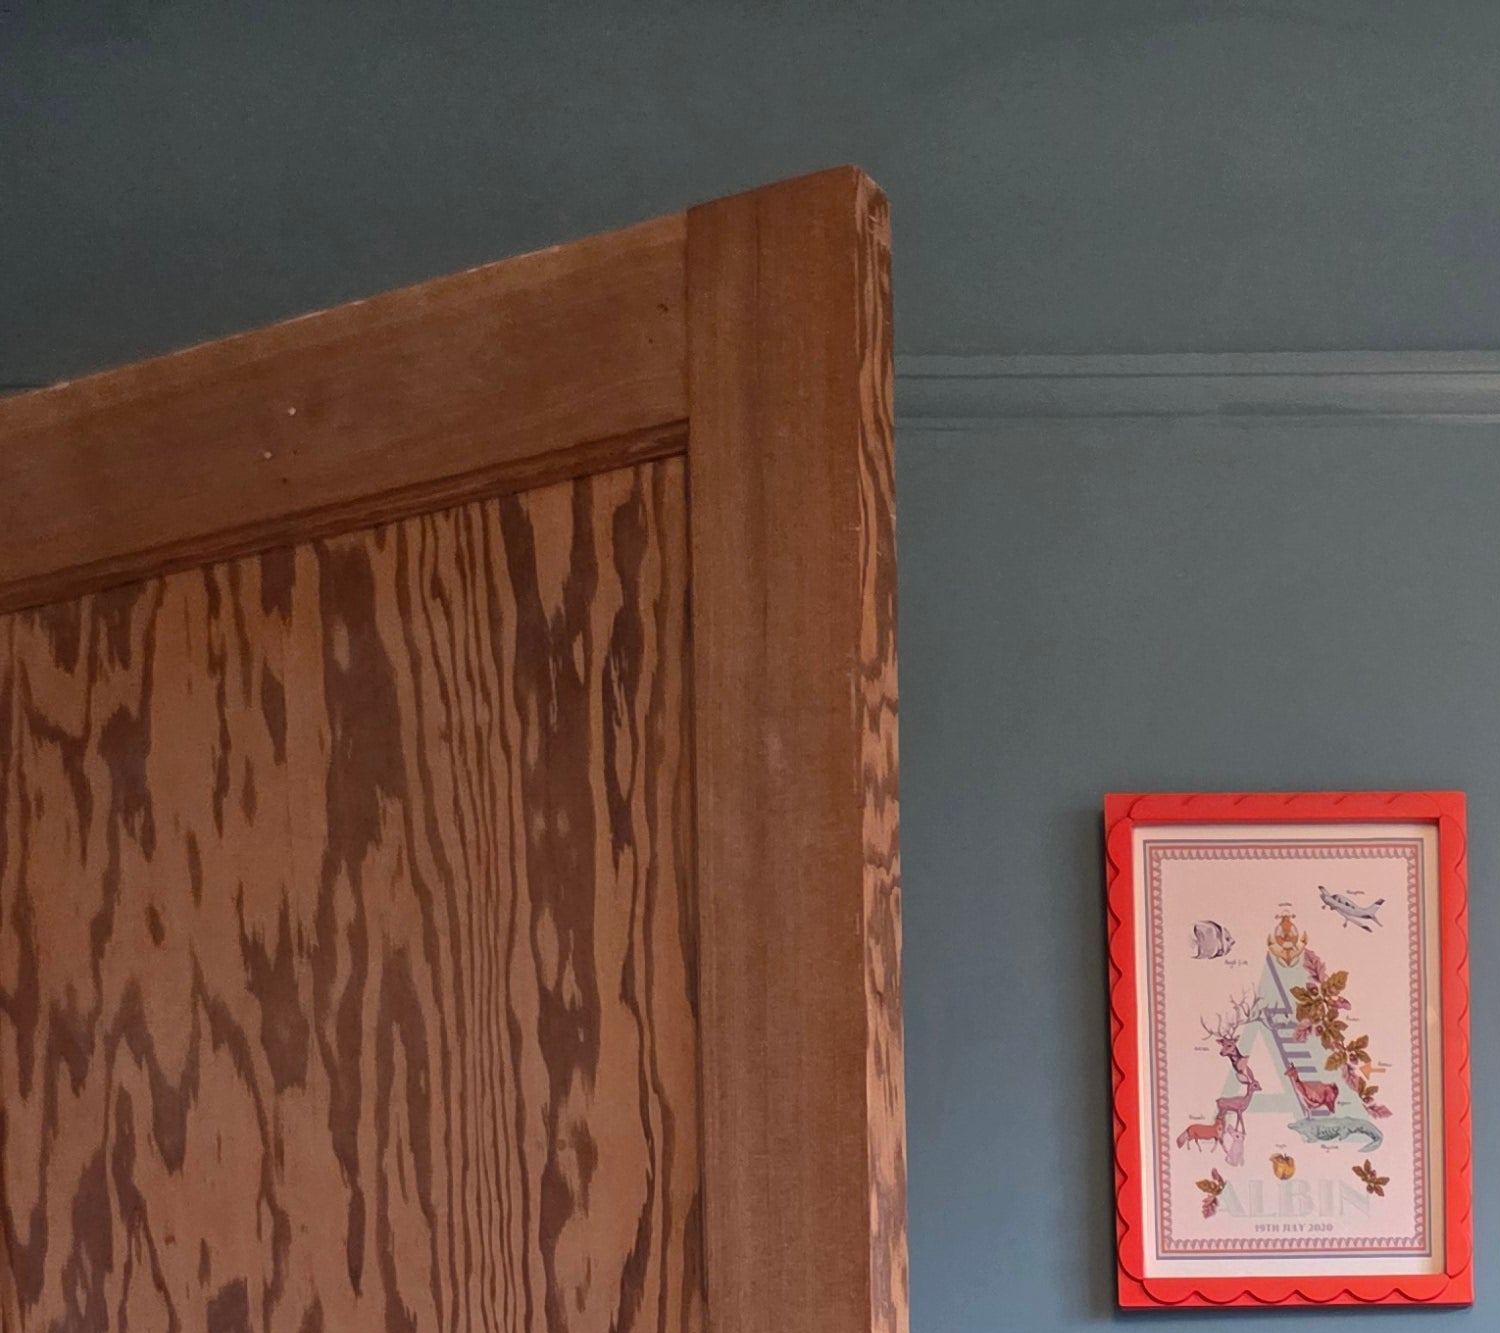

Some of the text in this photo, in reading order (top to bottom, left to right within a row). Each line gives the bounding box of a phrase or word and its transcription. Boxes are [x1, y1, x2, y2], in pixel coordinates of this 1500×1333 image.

[1219, 1179, 1371, 1218] ALBIN
[1254, 1223, 1334, 1233] 19TH JULY 2020
